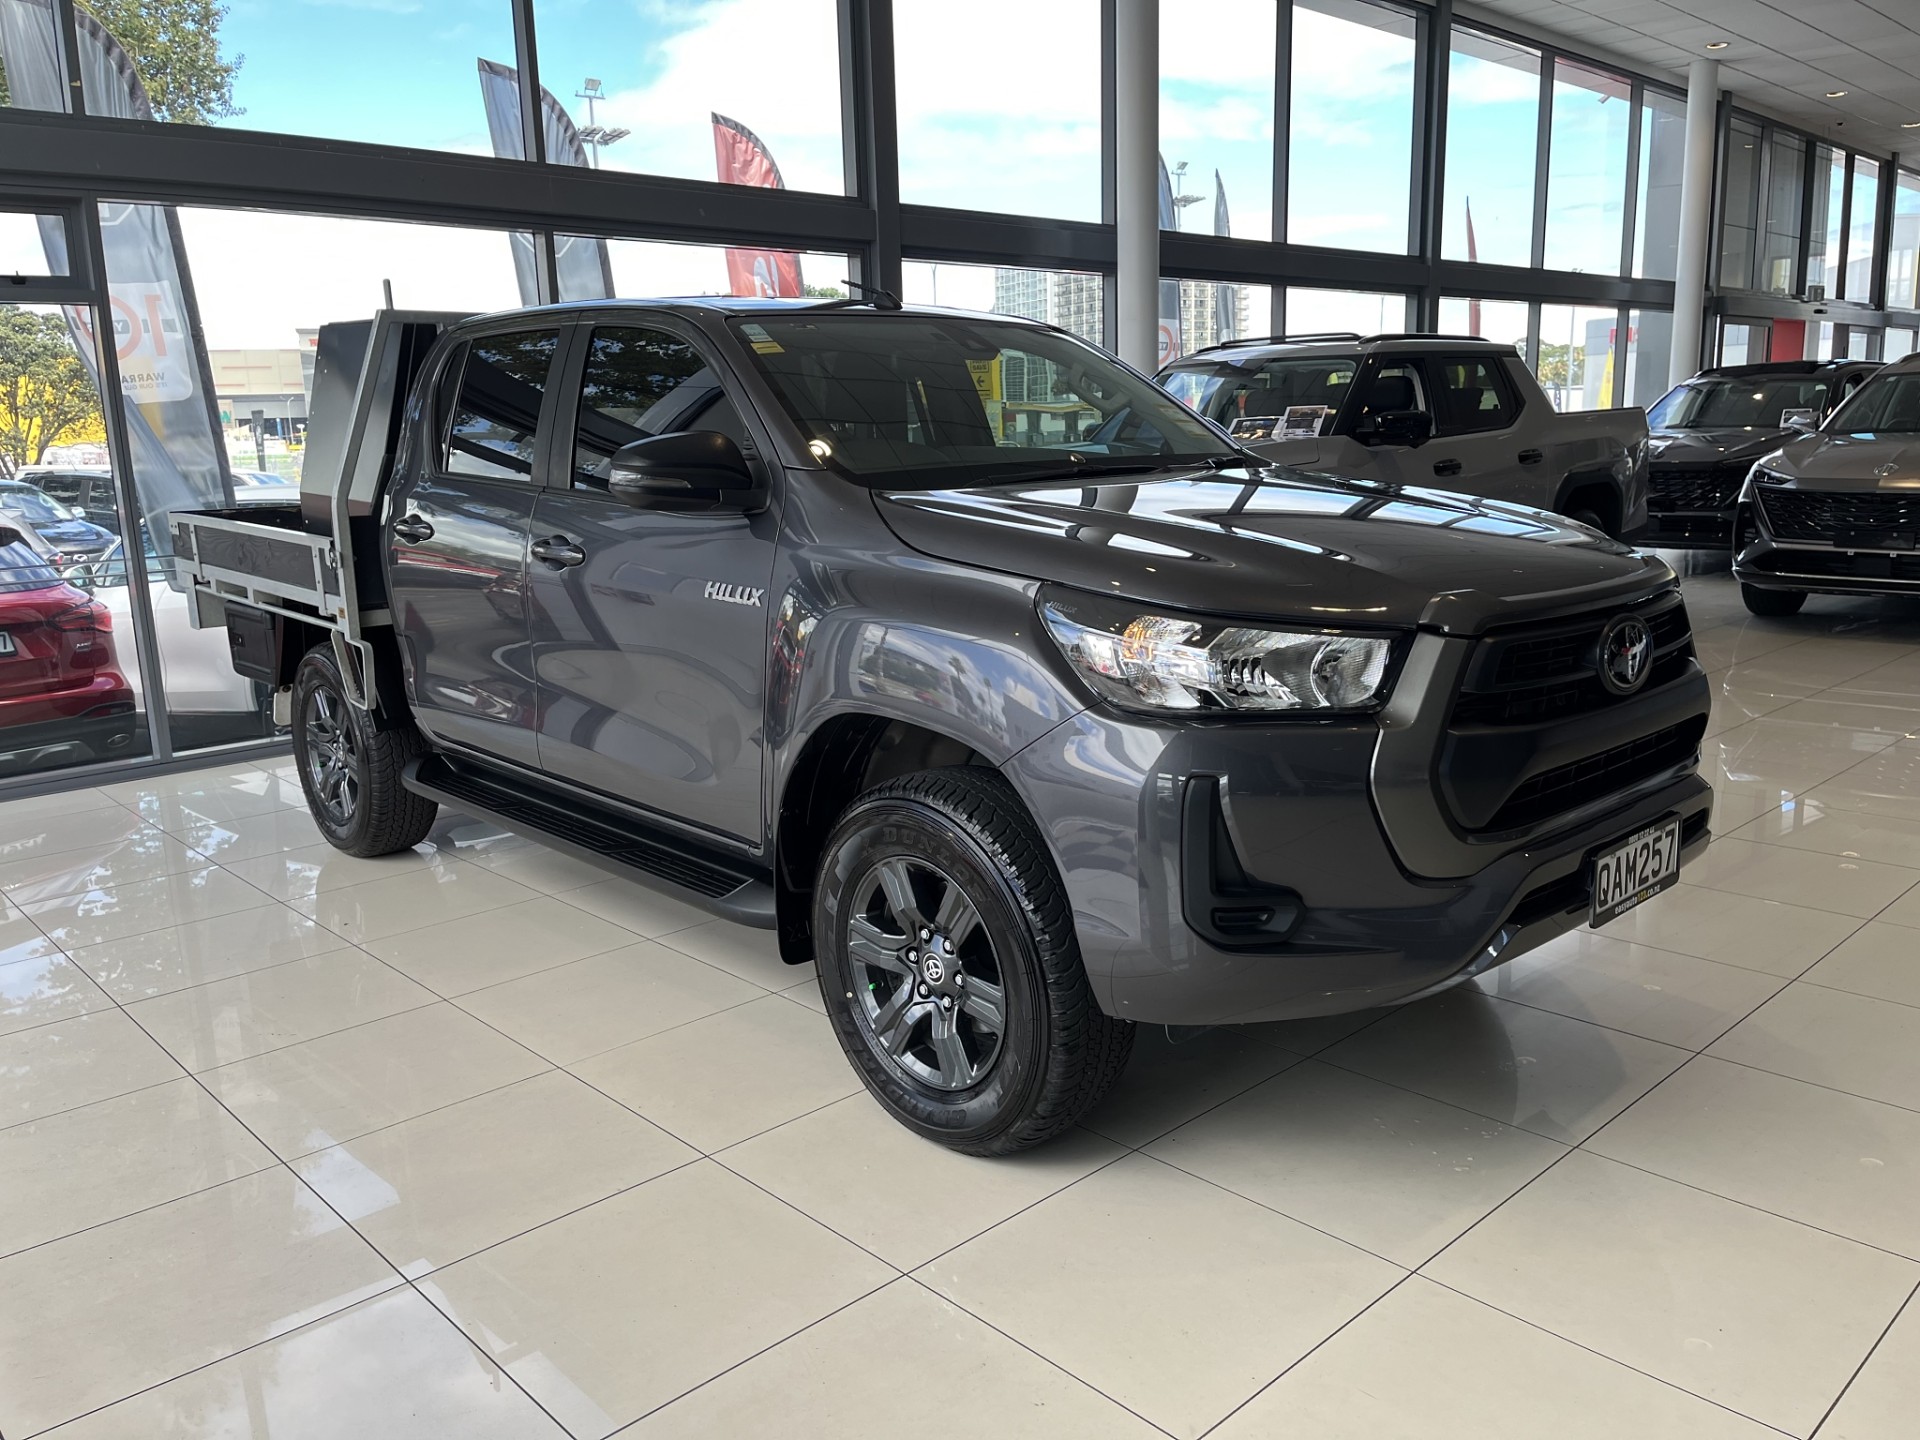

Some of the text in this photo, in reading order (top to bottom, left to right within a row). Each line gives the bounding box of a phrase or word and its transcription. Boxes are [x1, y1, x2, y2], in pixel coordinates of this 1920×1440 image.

[704, 581, 765, 607] HILUX
[1049, 601, 1078, 613] HILUX
[882, 826, 986, 902] DUNLOP
[1597, 828, 1675, 908] QAM257
